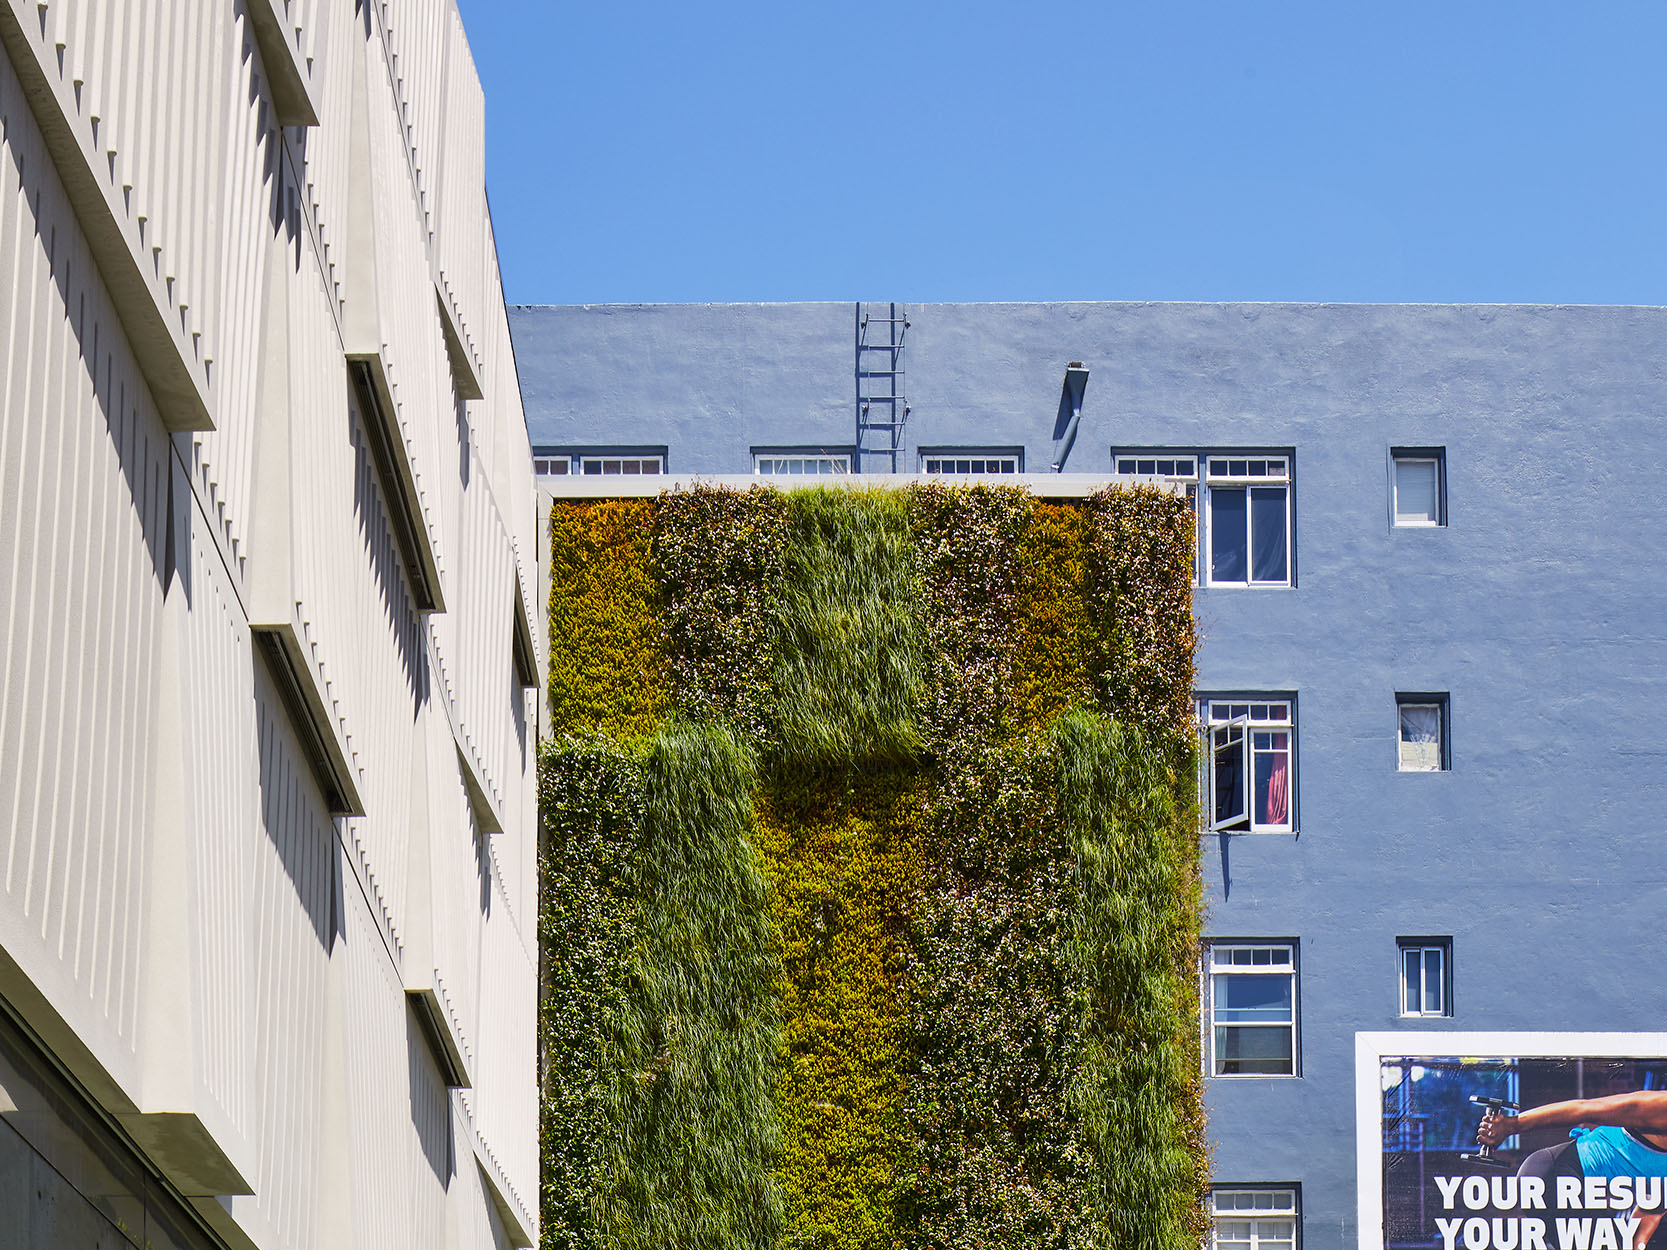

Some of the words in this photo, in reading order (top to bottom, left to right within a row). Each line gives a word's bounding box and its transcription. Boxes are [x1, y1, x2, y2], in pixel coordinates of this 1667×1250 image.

[1434, 1176, 1547, 1210] YOUR
[1556, 1176, 1667, 1210] RESU
[1435, 1217, 1548, 1250] YOUR
[1555, 1217, 1646, 1250] WAY.
